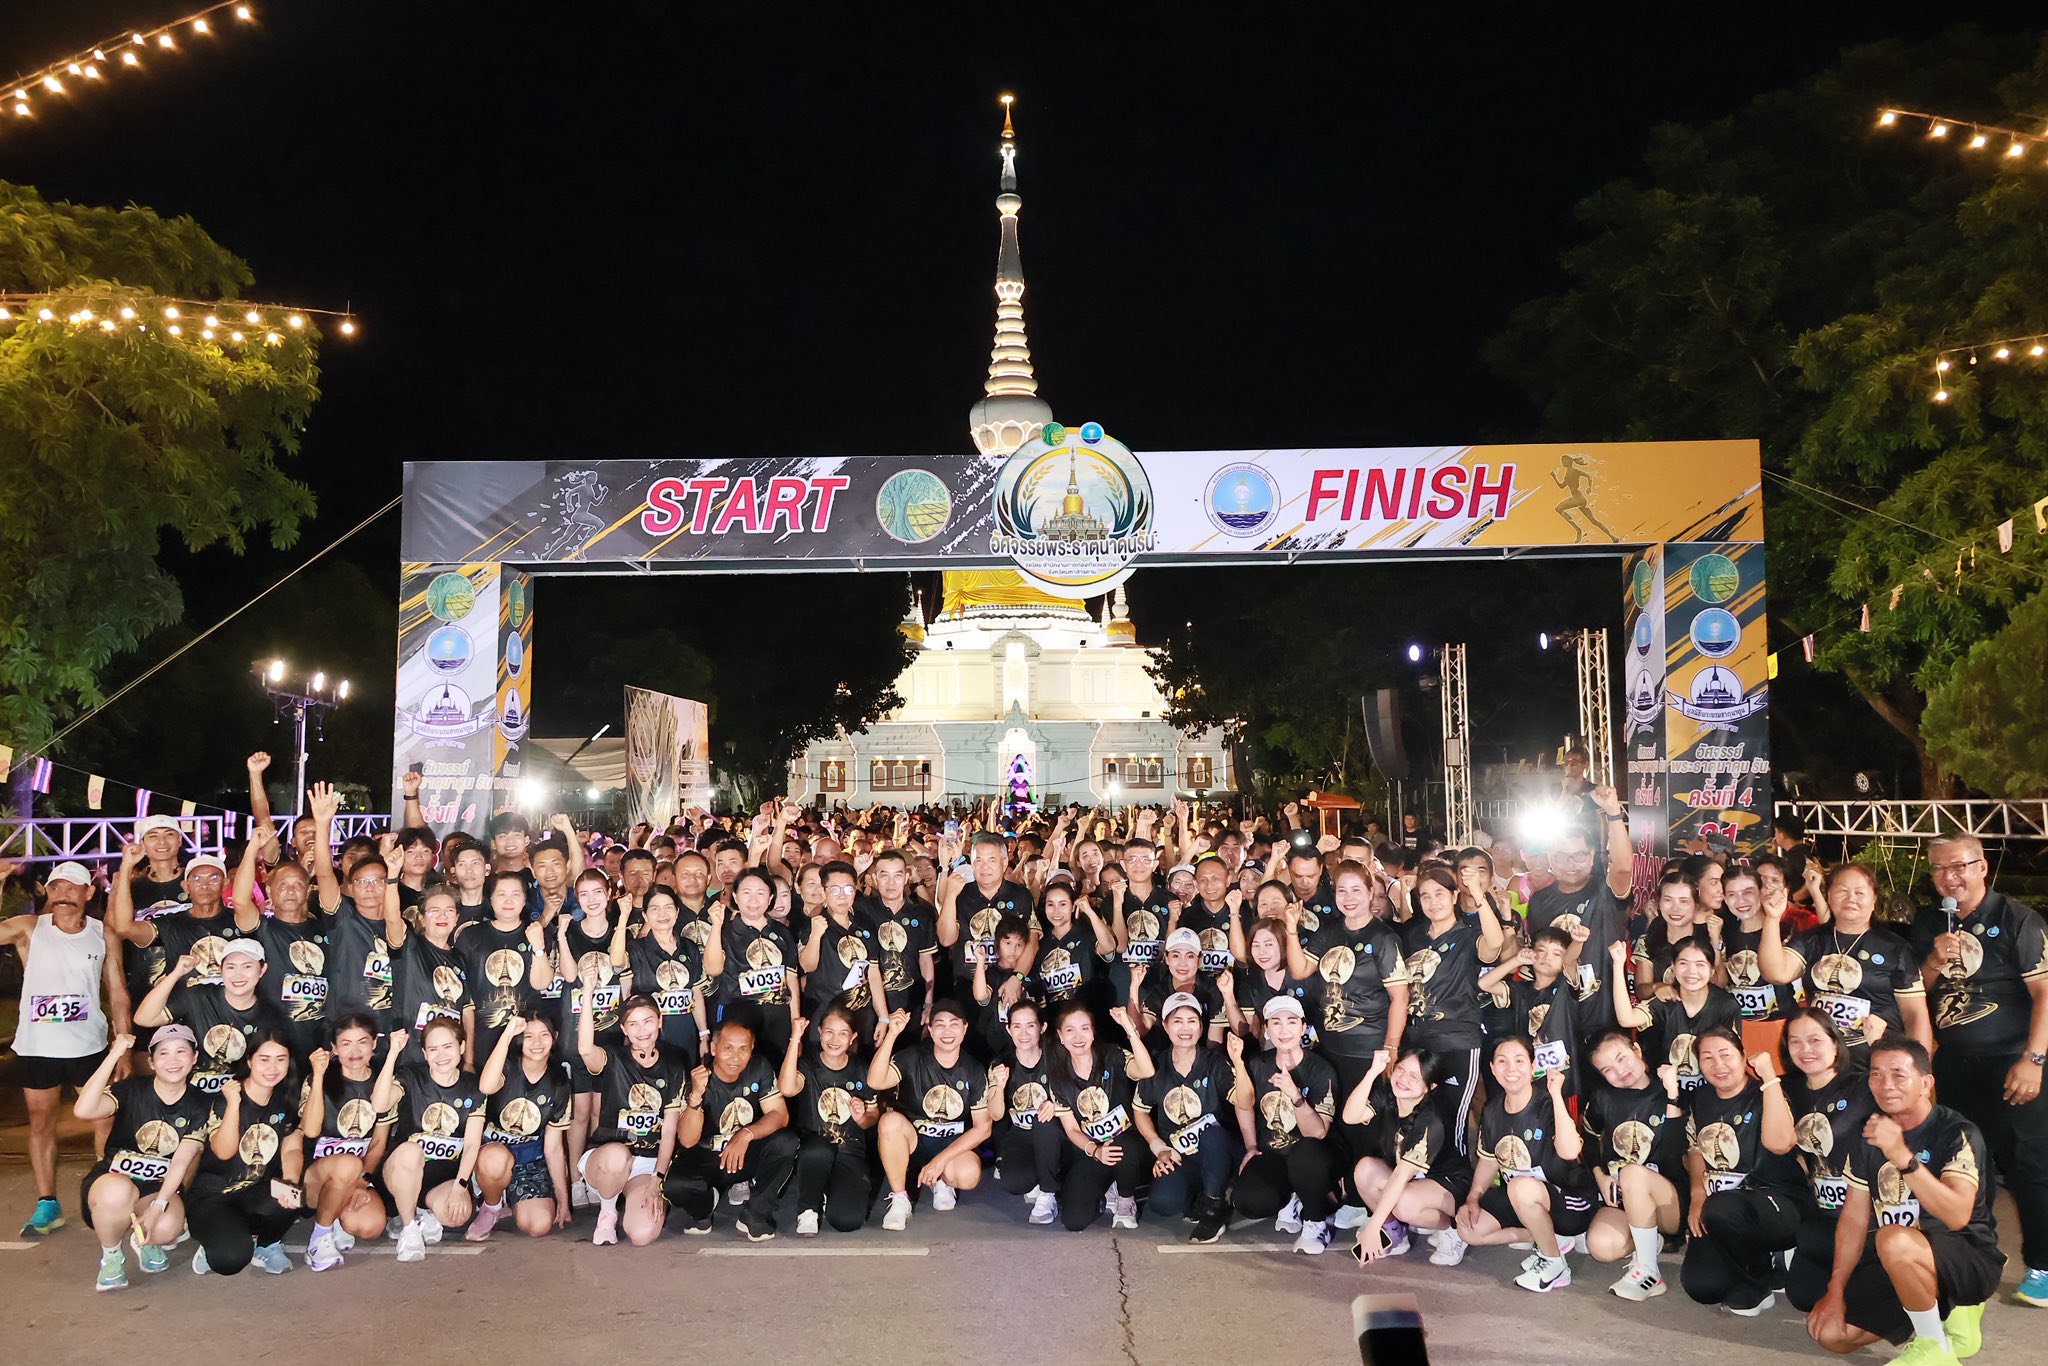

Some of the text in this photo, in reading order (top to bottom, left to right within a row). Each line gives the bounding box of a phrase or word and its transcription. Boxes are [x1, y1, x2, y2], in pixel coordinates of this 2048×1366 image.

[1304, 464, 1517, 523] FINISH
[641, 475, 851, 536] START
[1696, 742, 1745, 759] อัศจรรย์
[1670, 757, 1770, 778] พระธาตุนาดูน รัน
[1687, 778, 1754, 807] ครั้งที่ 4
[461, 803, 477, 823] 4
[1631, 854, 1667, 889] MAY
[1127, 944, 1160, 957] V005
[291, 980, 327, 997] 0689
[745, 972, 782, 989] V033
[1043, 971, 1075, 989] V002
[37, 1003, 80, 1017] 0495
[1815, 999, 1858, 1022] 0523
[1084, 1114, 1121, 1138] V031
[119, 1157, 167, 1179] 0252
